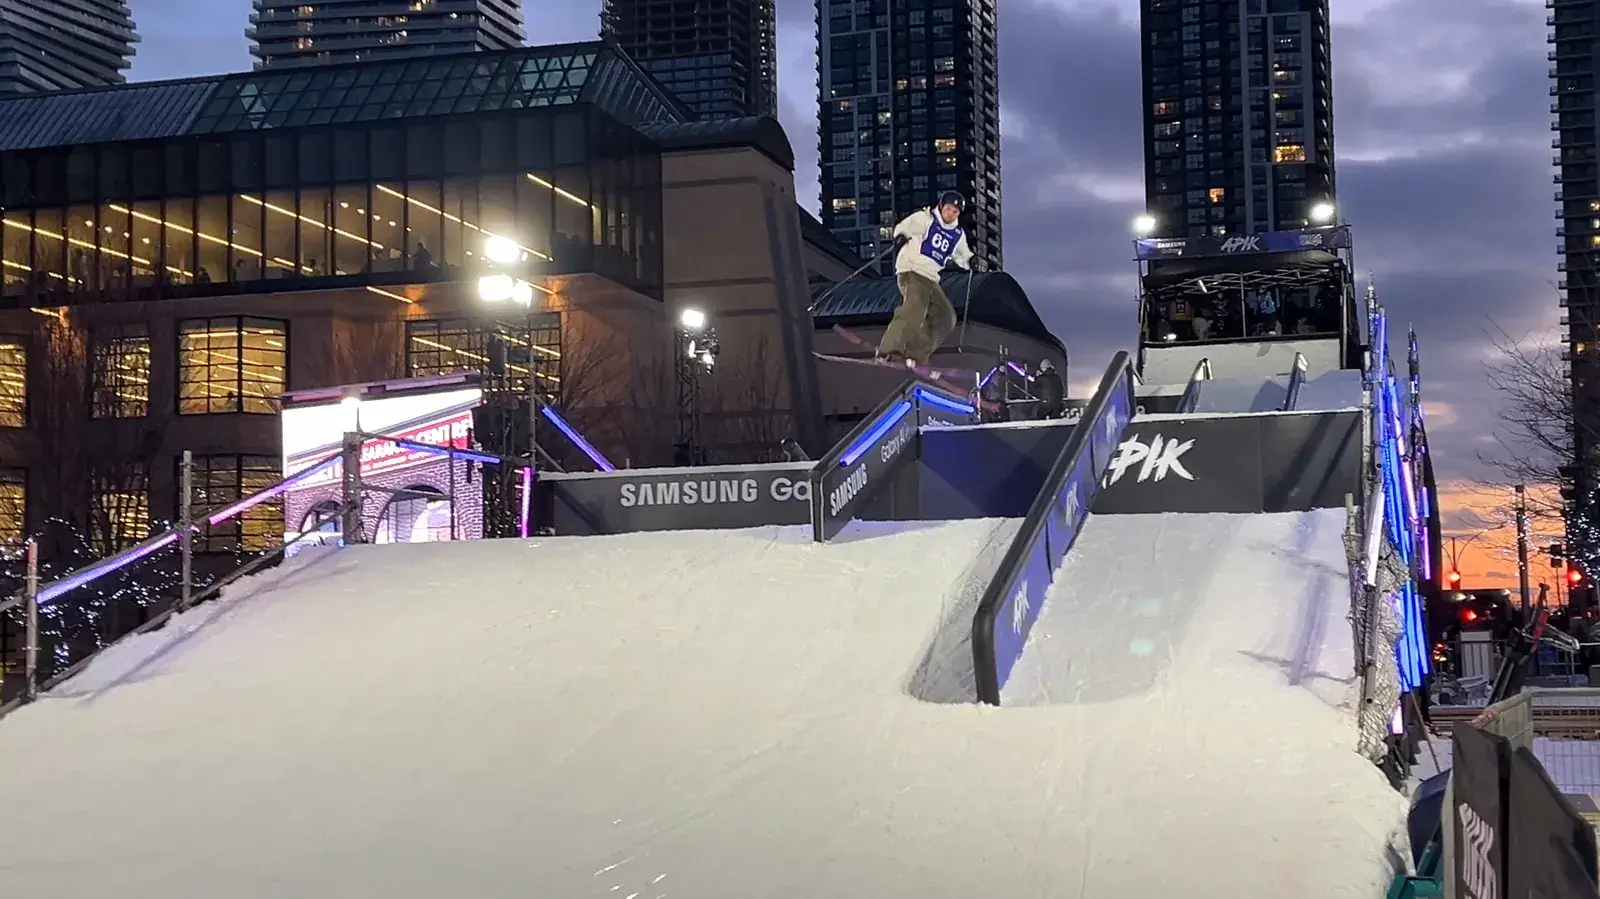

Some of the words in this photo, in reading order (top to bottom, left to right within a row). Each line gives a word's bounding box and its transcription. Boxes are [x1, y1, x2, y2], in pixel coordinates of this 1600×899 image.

[1220, 235, 1260, 253] APIK
[620, 479, 758, 506] SAMSUNG
[830, 463, 868, 517] SAMSUNG
